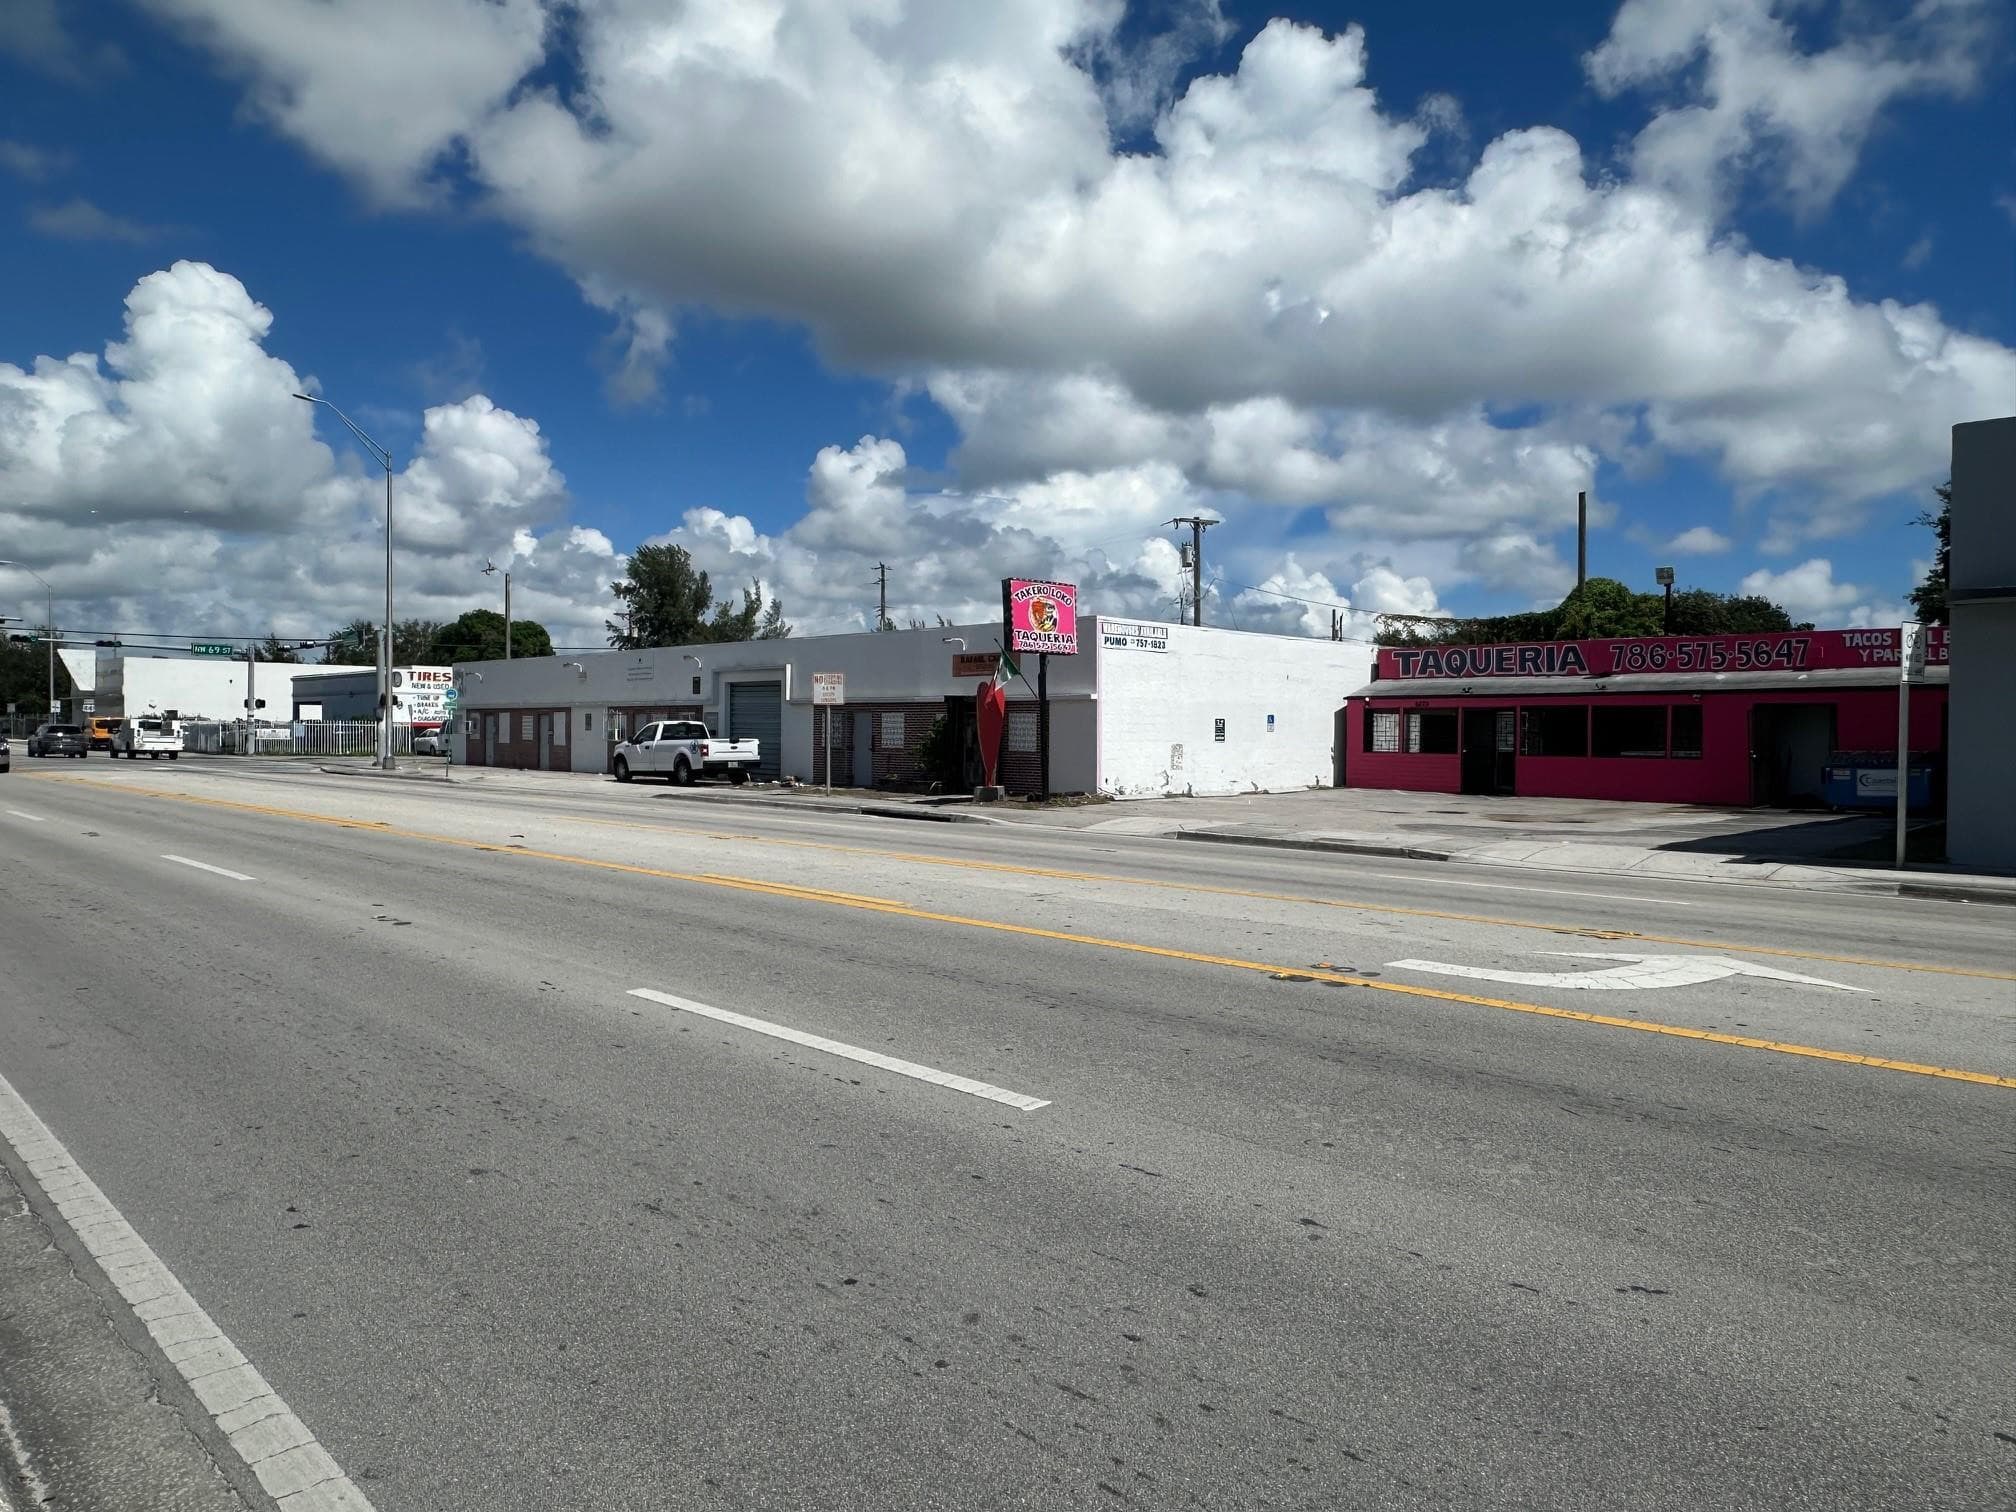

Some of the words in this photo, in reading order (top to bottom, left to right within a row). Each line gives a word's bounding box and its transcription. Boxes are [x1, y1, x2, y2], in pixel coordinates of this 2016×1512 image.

[1015, 585, 1049, 601] TAKERO
[1051, 588, 1072, 606] LOKO
[1015, 630, 1074, 644] TAQUERIA
[1104, 636, 1127, 646] PUMO
[1843, 633, 1892, 647] TACOS
[1392, 645, 1589, 678] TAQUERIA
[1859, 649, 1870, 662] Y
[407, 671, 452, 682] TIRES
